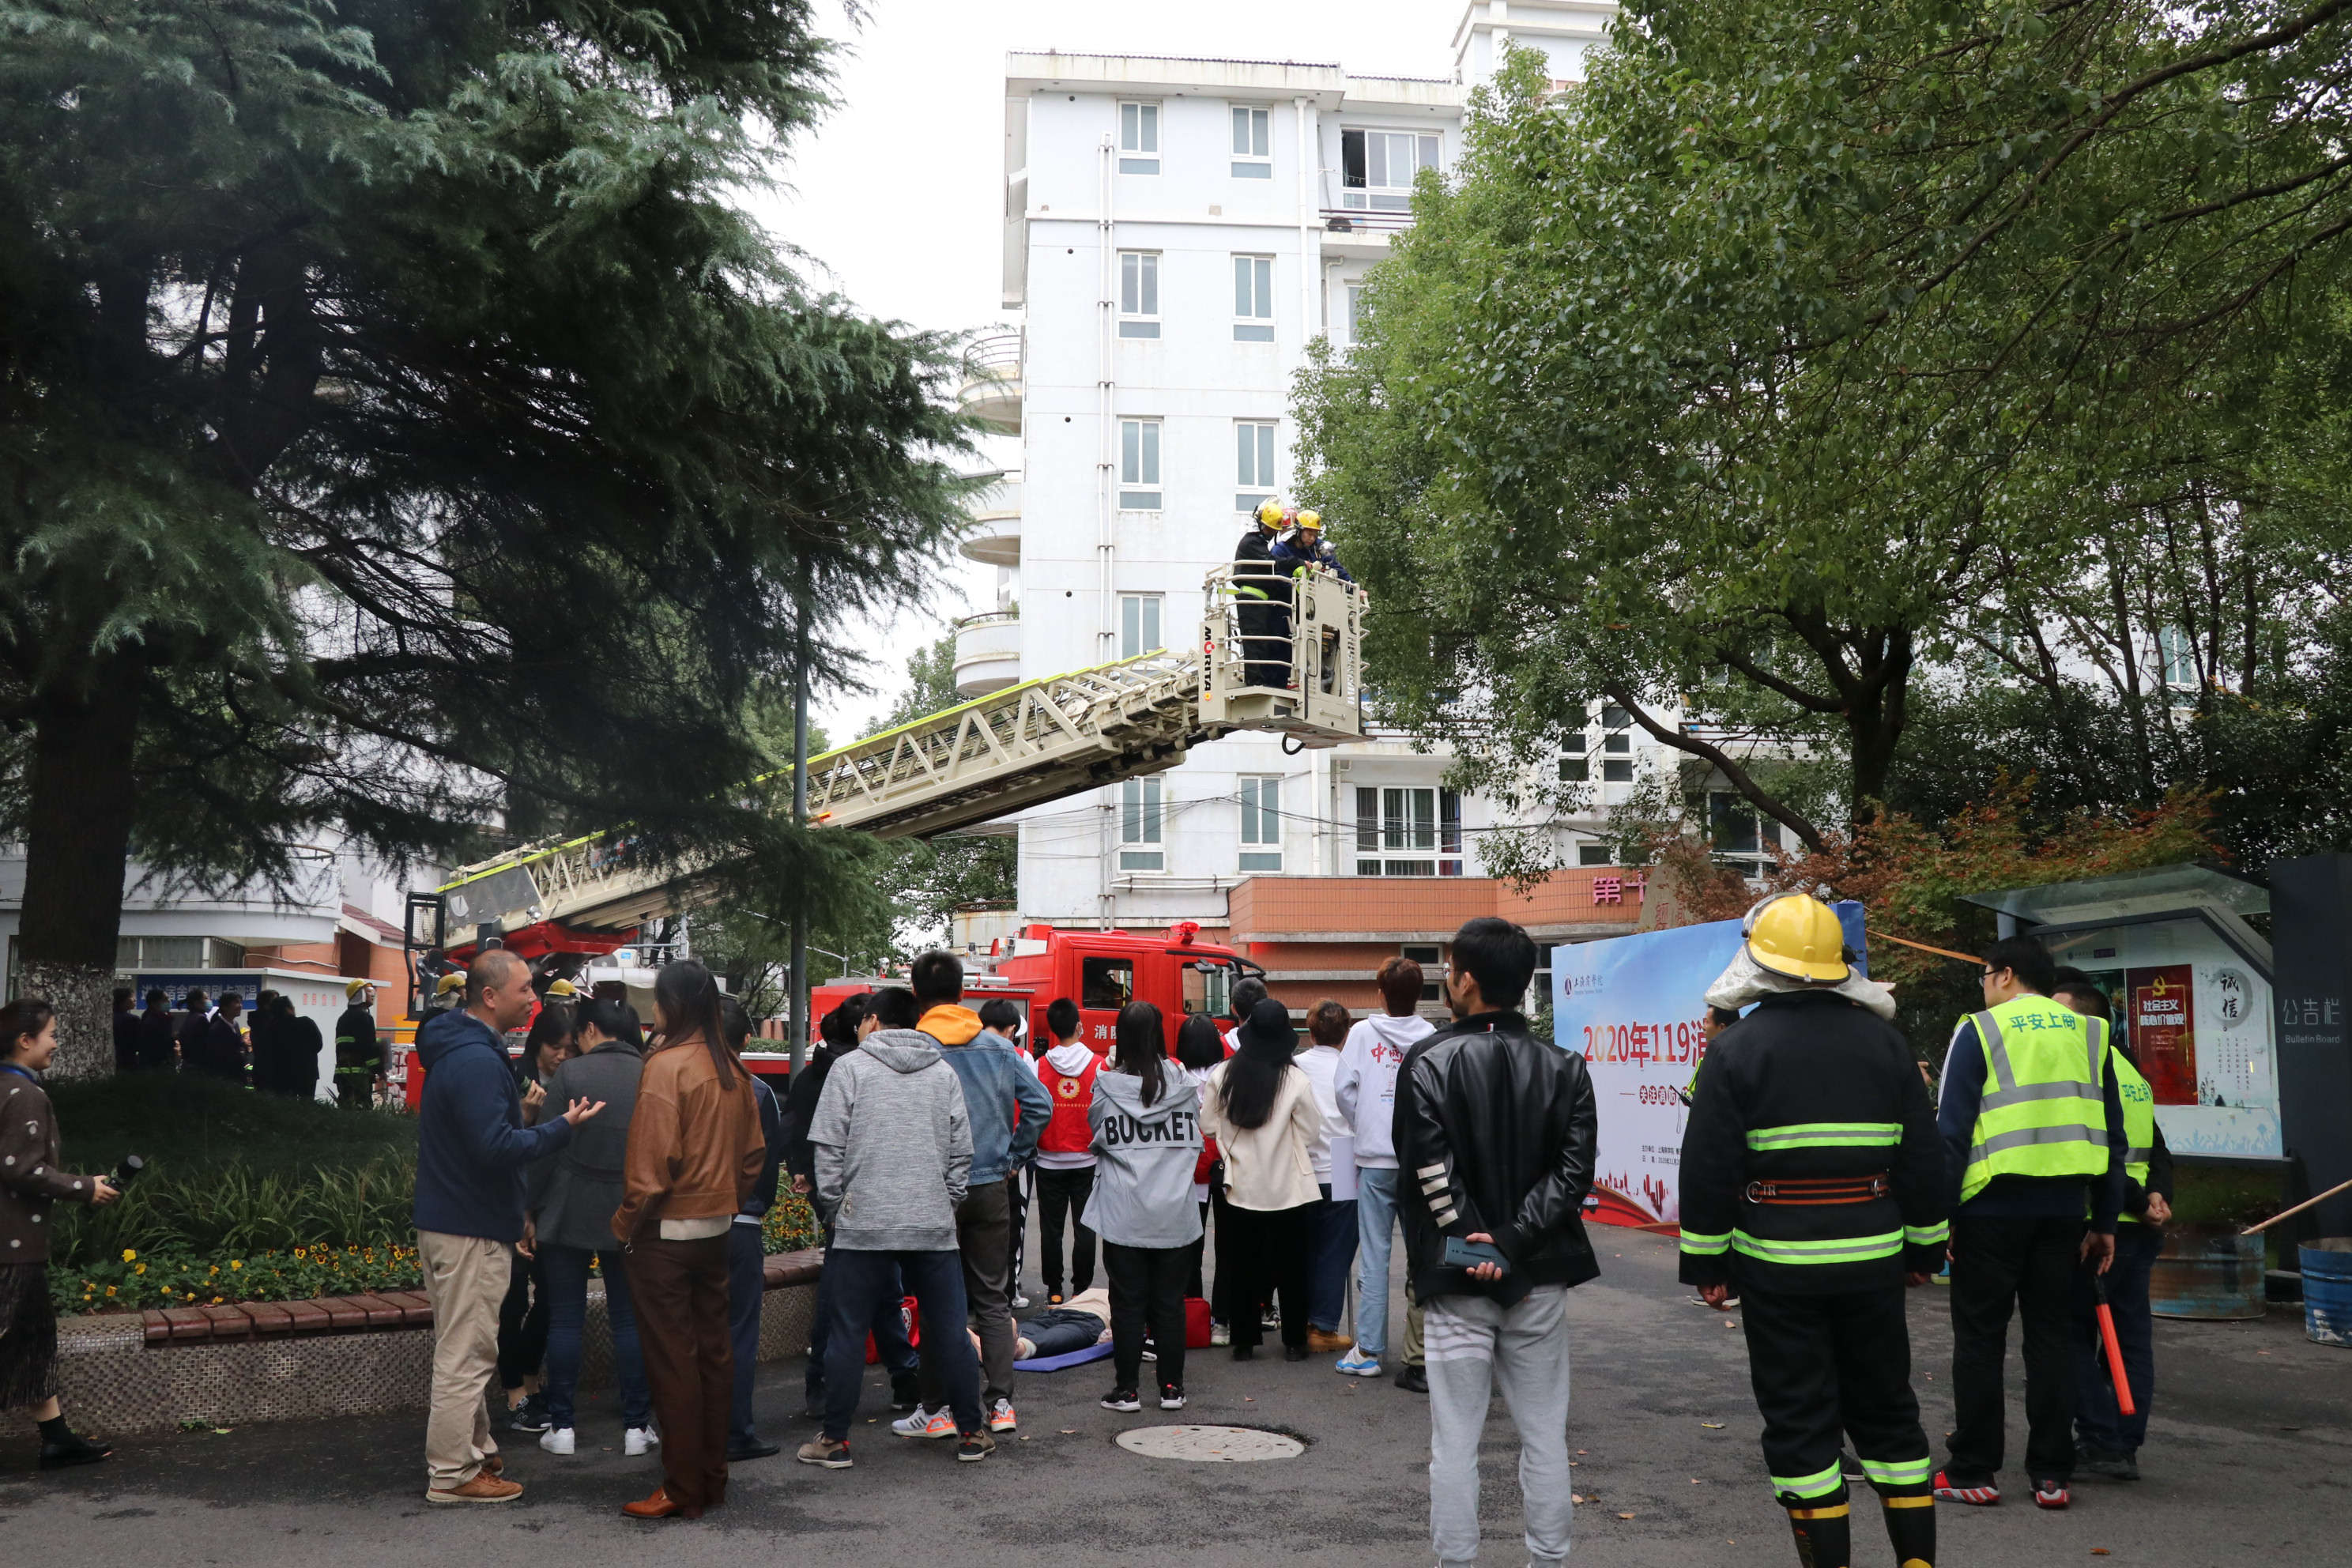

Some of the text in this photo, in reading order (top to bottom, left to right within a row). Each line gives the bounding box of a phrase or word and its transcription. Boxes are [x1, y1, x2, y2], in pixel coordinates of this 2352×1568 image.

[1204, 625, 1215, 691] MORITA
[2143, 999, 2179, 1012] 社会主义
[2282, 997, 2340, 1026] 公告栏
[2010, 1012, 2076, 1033] 平安上商
[2140, 1013, 2184, 1026] 核心价值观
[2285, 1034, 2340, 1044] Bulletin Board
[1104, 1111, 1194, 1146] BUCKET
